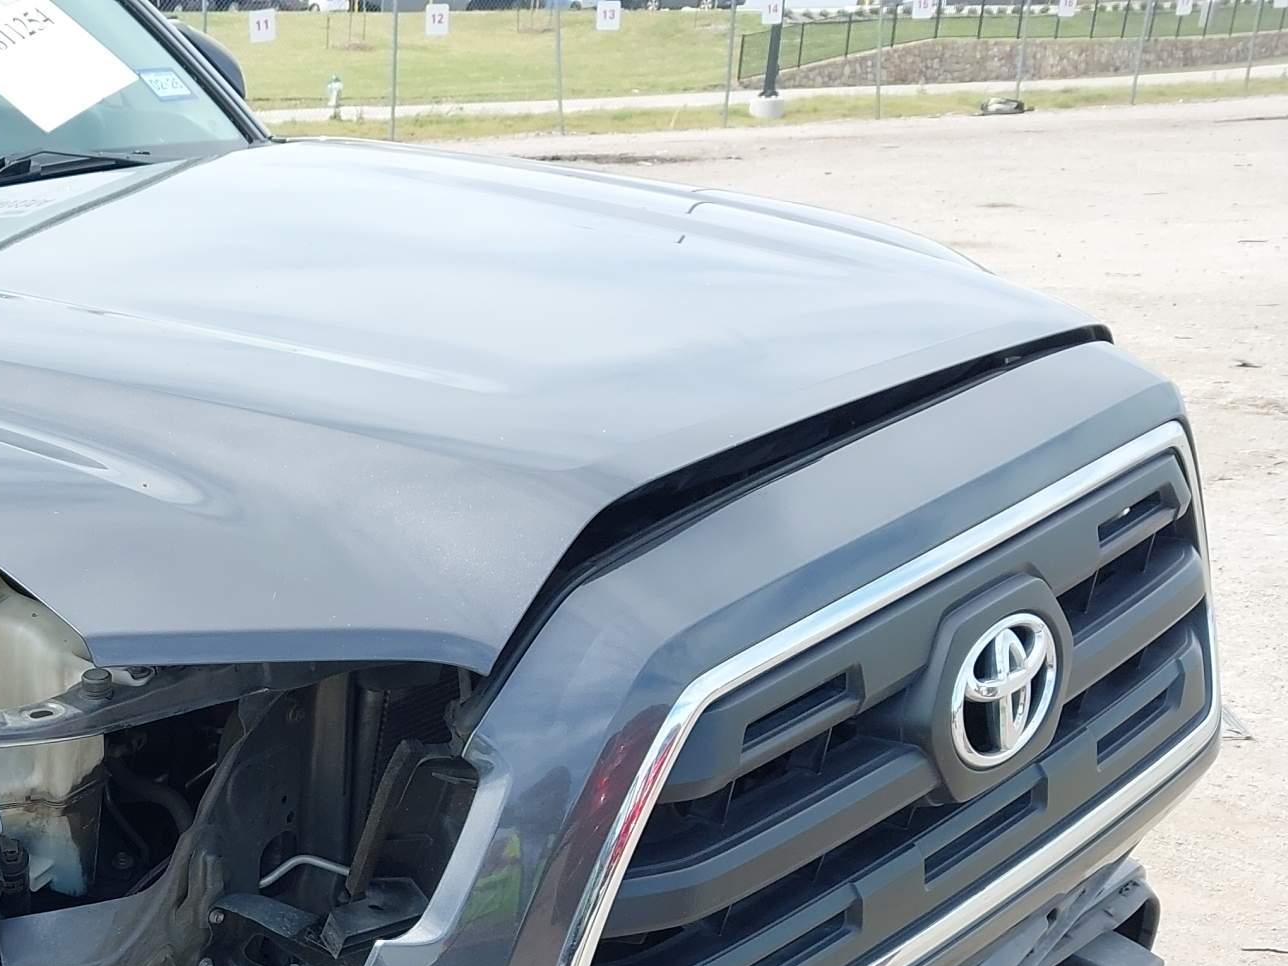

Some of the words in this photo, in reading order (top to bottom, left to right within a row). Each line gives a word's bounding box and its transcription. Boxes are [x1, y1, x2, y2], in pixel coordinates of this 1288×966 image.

[768, 3, 778, 14] 14
[431, 13, 444, 25] 12
[602, 9, 616, 20] 13
[255, 18, 269, 31] 11
